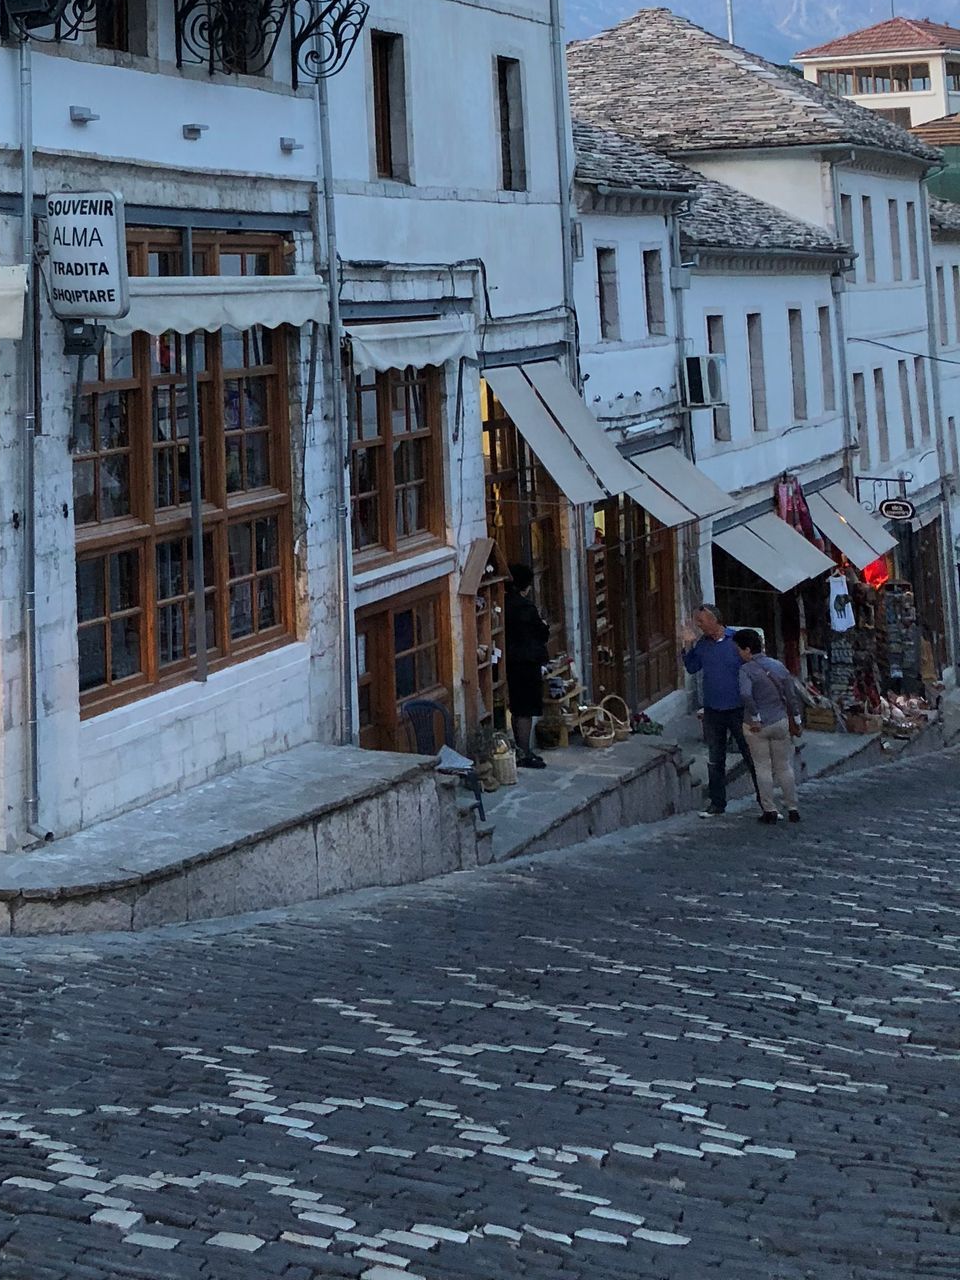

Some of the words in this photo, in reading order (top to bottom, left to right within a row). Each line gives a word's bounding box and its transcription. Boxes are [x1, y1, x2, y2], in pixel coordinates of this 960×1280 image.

[48, 200, 113, 216] SOUVENIR
[53, 226, 103, 247] ALMA
[53, 261, 109, 276] TRADITA
[53, 287, 115, 304] SHQIPTARE
